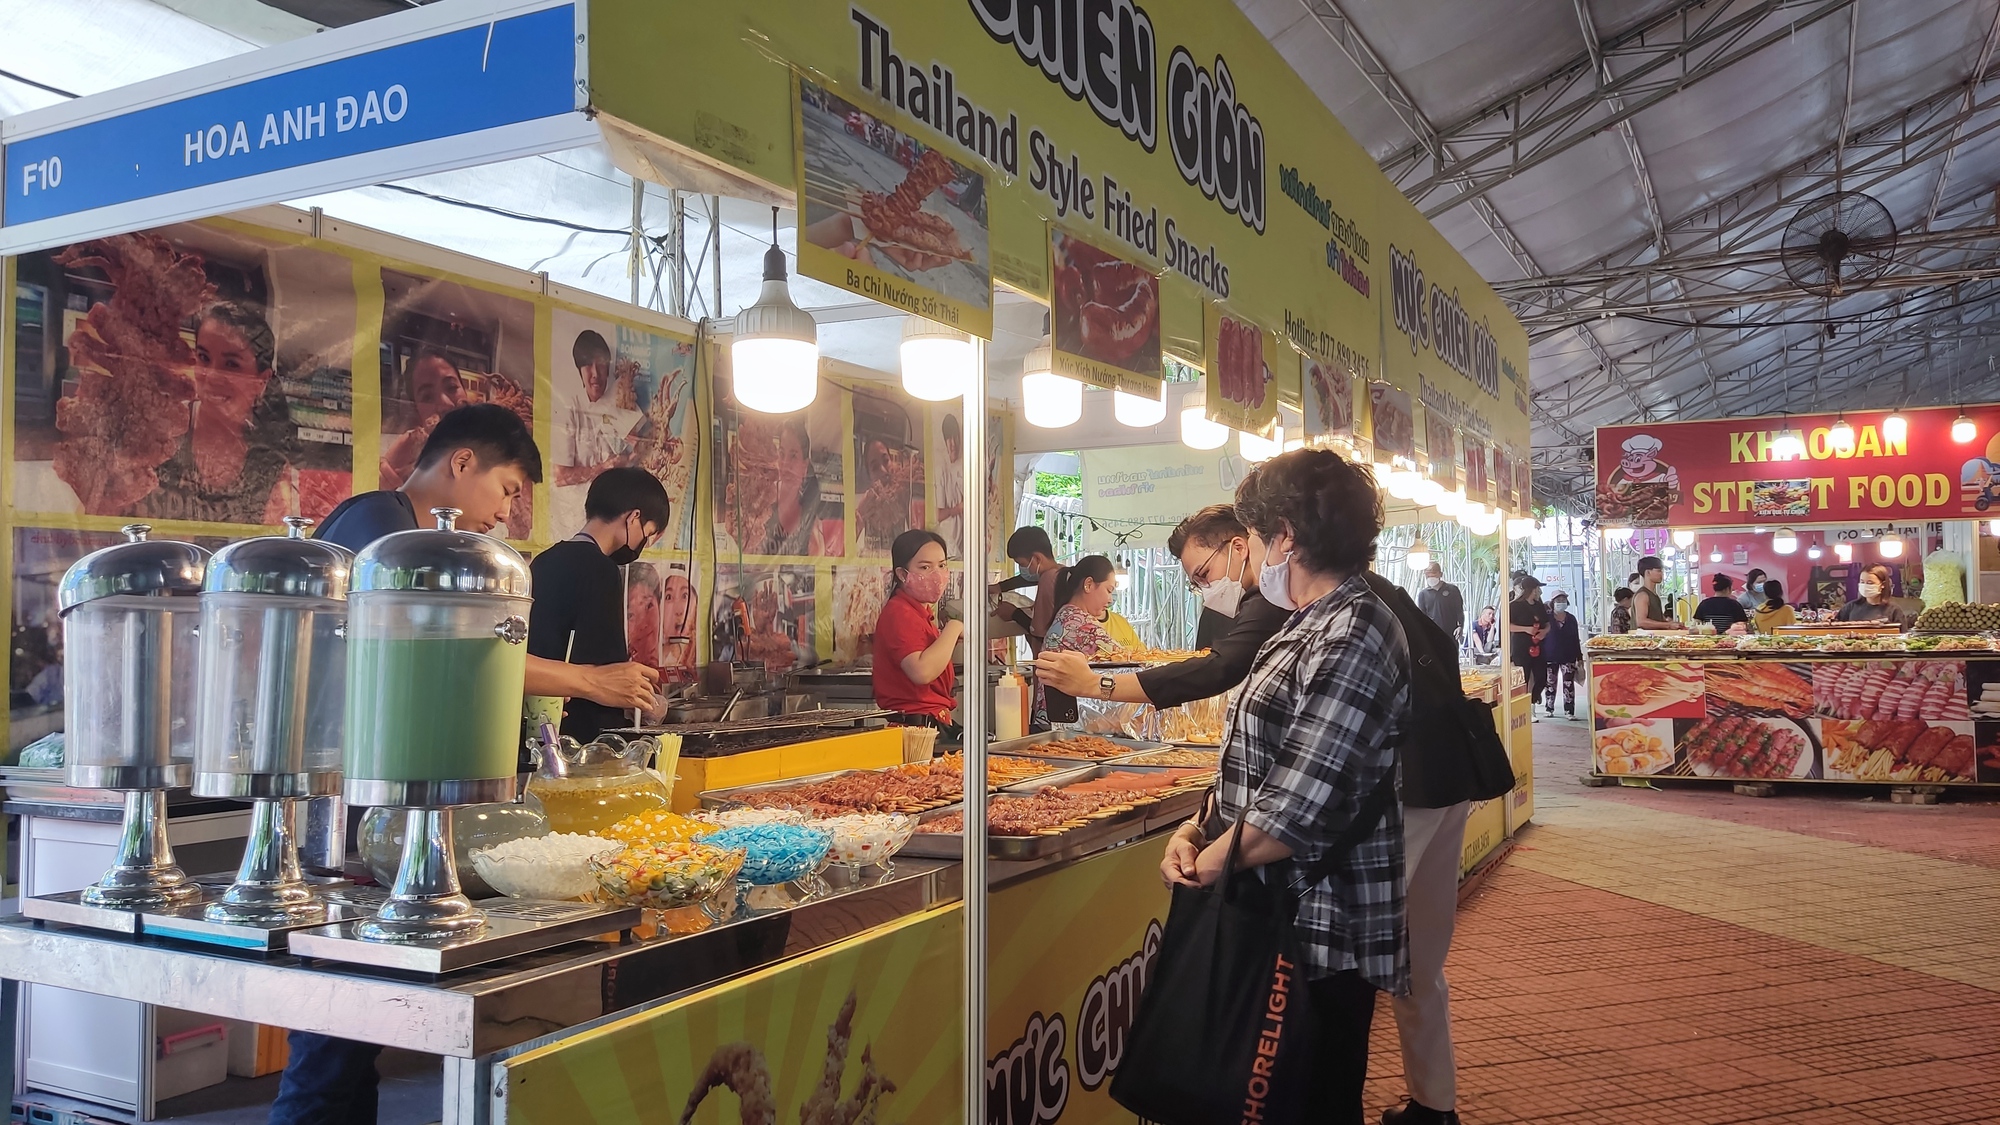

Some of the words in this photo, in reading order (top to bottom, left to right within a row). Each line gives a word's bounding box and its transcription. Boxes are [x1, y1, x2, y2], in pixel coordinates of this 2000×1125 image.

[184, 121, 251, 167] HOA
[259, 102, 327, 150] ANH
[335, 83, 410, 134] ĐAO
[1167, 45, 1265, 236] GIÒN
[22, 155, 62, 196] F10
[852, 8, 1018, 177] Thailand
[1029, 130, 1095, 219] Style
[1104, 176, 1158, 258] Fried
[1164, 218, 1230, 298] Snacks
[846, 268, 860, 289] Ba
[863, 275, 881, 296] Chỉ
[883, 282, 920, 314] Nướng
[922, 296, 938, 317] Sốt
[940, 303, 959, 324] Thái
[1284, 308, 1318, 353] Hotline:
[1075, 361, 1091, 378] Xích
[1092, 366, 1116, 388] Nướng
[1692, 477, 1835, 514] STRT
[1848, 473, 1951, 509] FOOD
